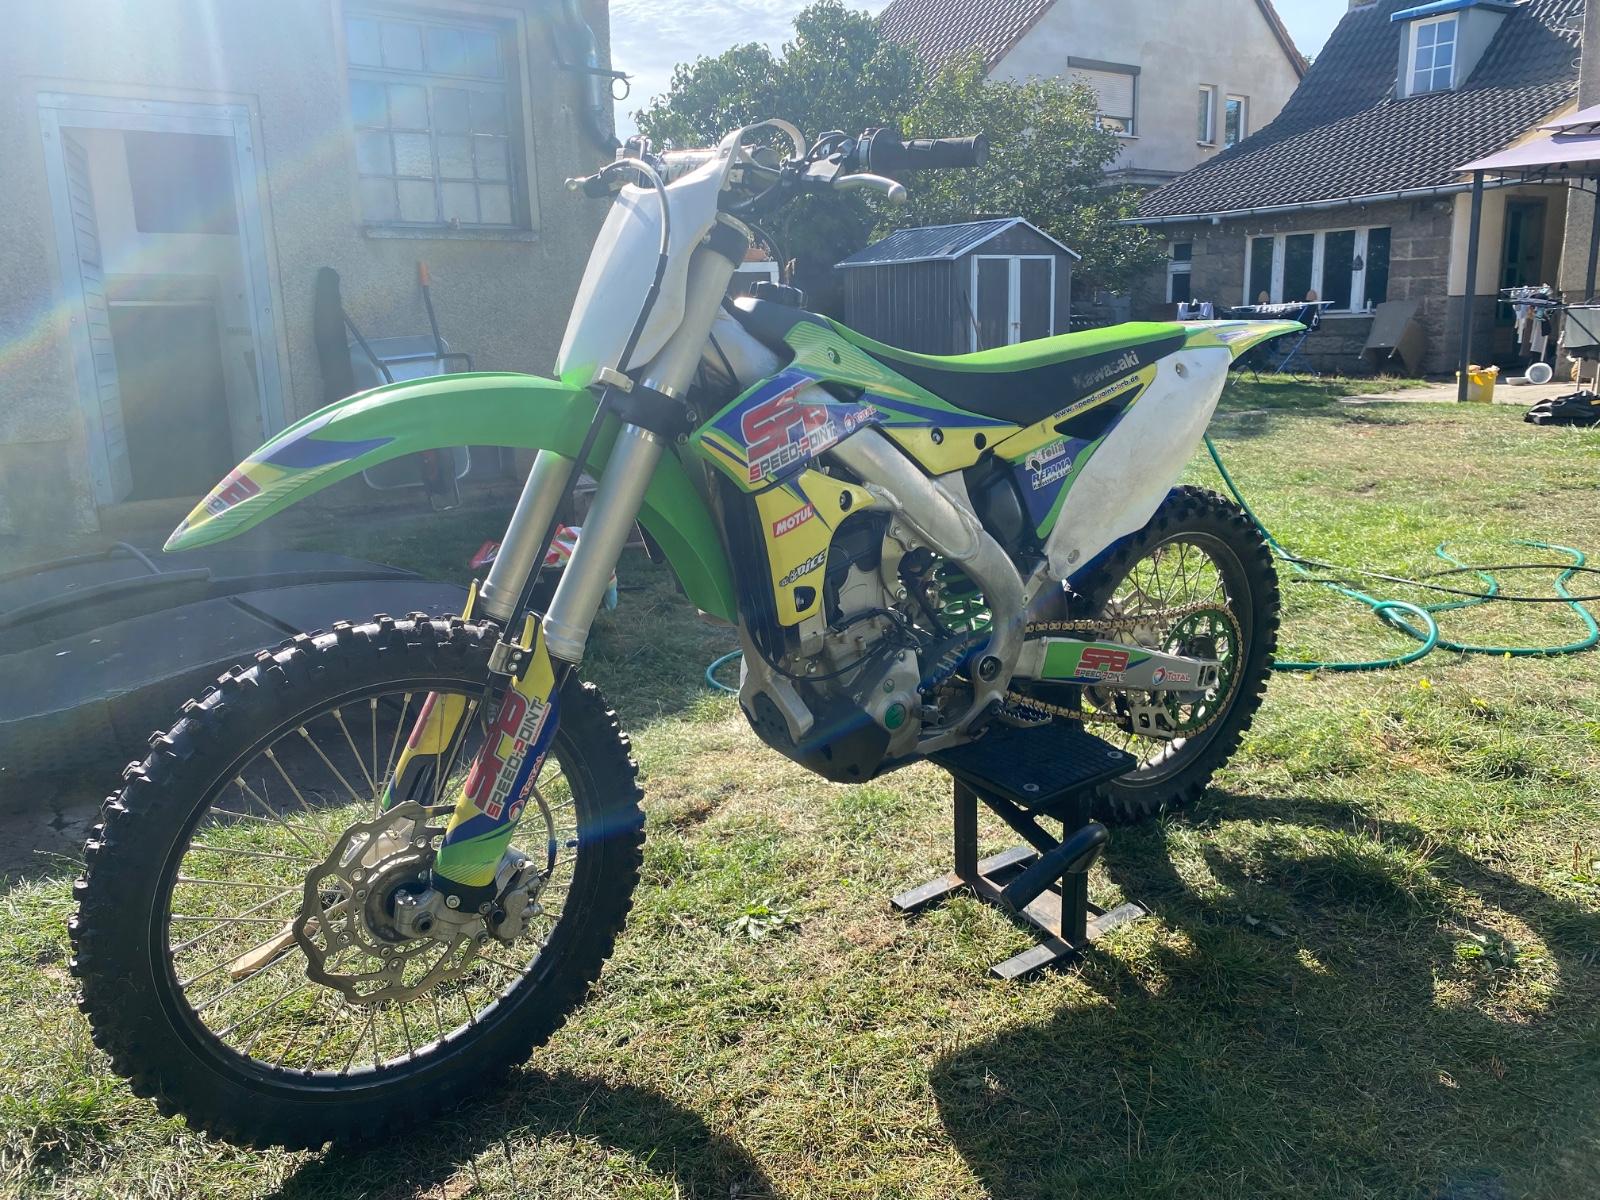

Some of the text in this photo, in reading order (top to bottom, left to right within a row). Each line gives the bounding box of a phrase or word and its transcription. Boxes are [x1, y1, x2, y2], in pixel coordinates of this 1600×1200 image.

[1072, 350, 1139, 389] Kawasaki
[775, 505, 813, 536] MOTUL
[1167, 671, 1191, 682] TOTAL
[519, 752, 546, 798] TOTAL
